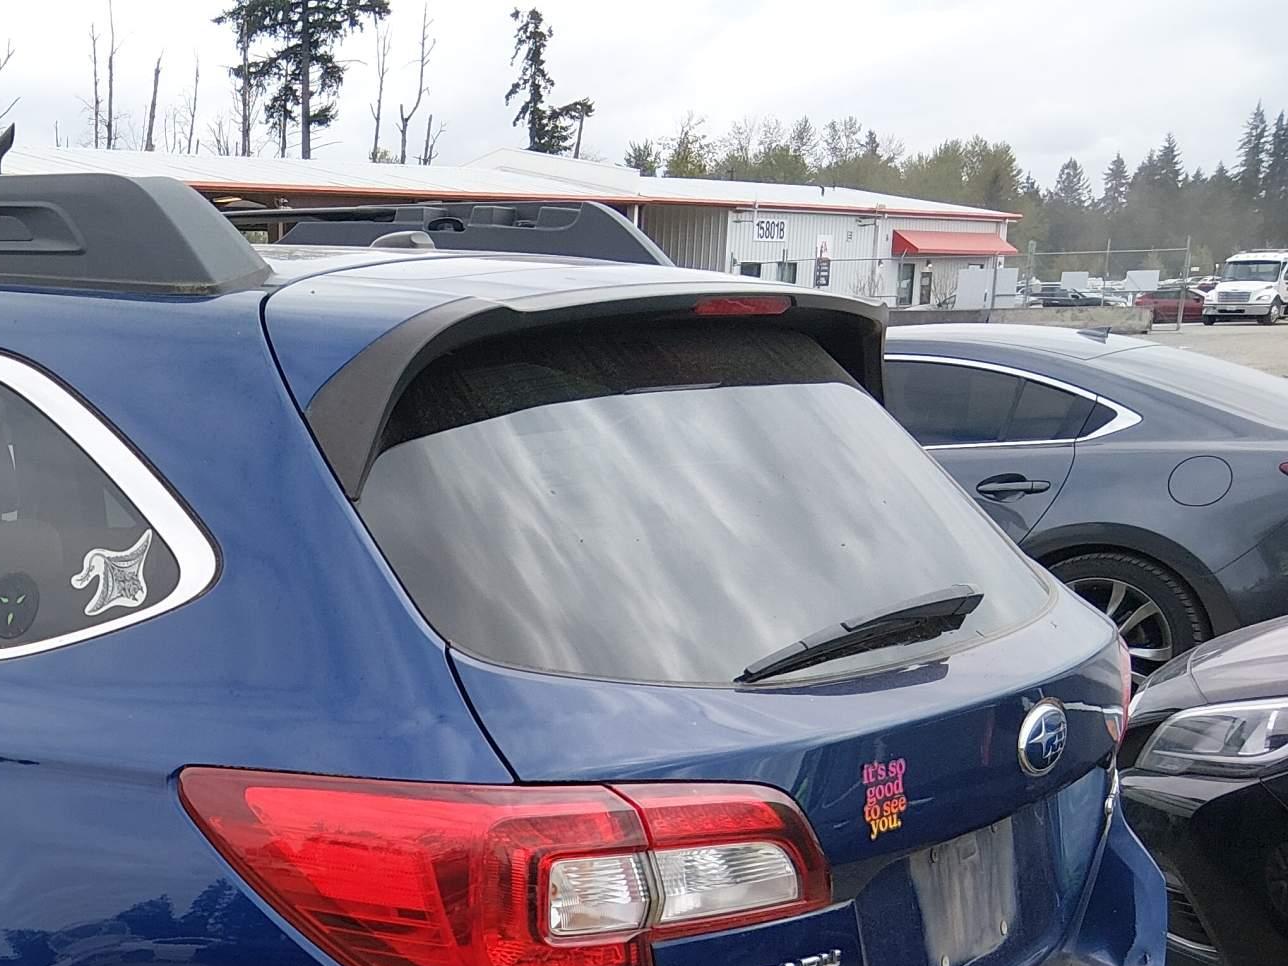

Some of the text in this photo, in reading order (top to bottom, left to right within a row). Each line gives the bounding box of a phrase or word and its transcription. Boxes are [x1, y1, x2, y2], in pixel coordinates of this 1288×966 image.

[755, 220, 785, 240] 15801B
[888, 758, 907, 778] so
[867, 778, 904, 806] good
[864, 795, 907, 822] to see
[870, 814, 902, 840] you.
